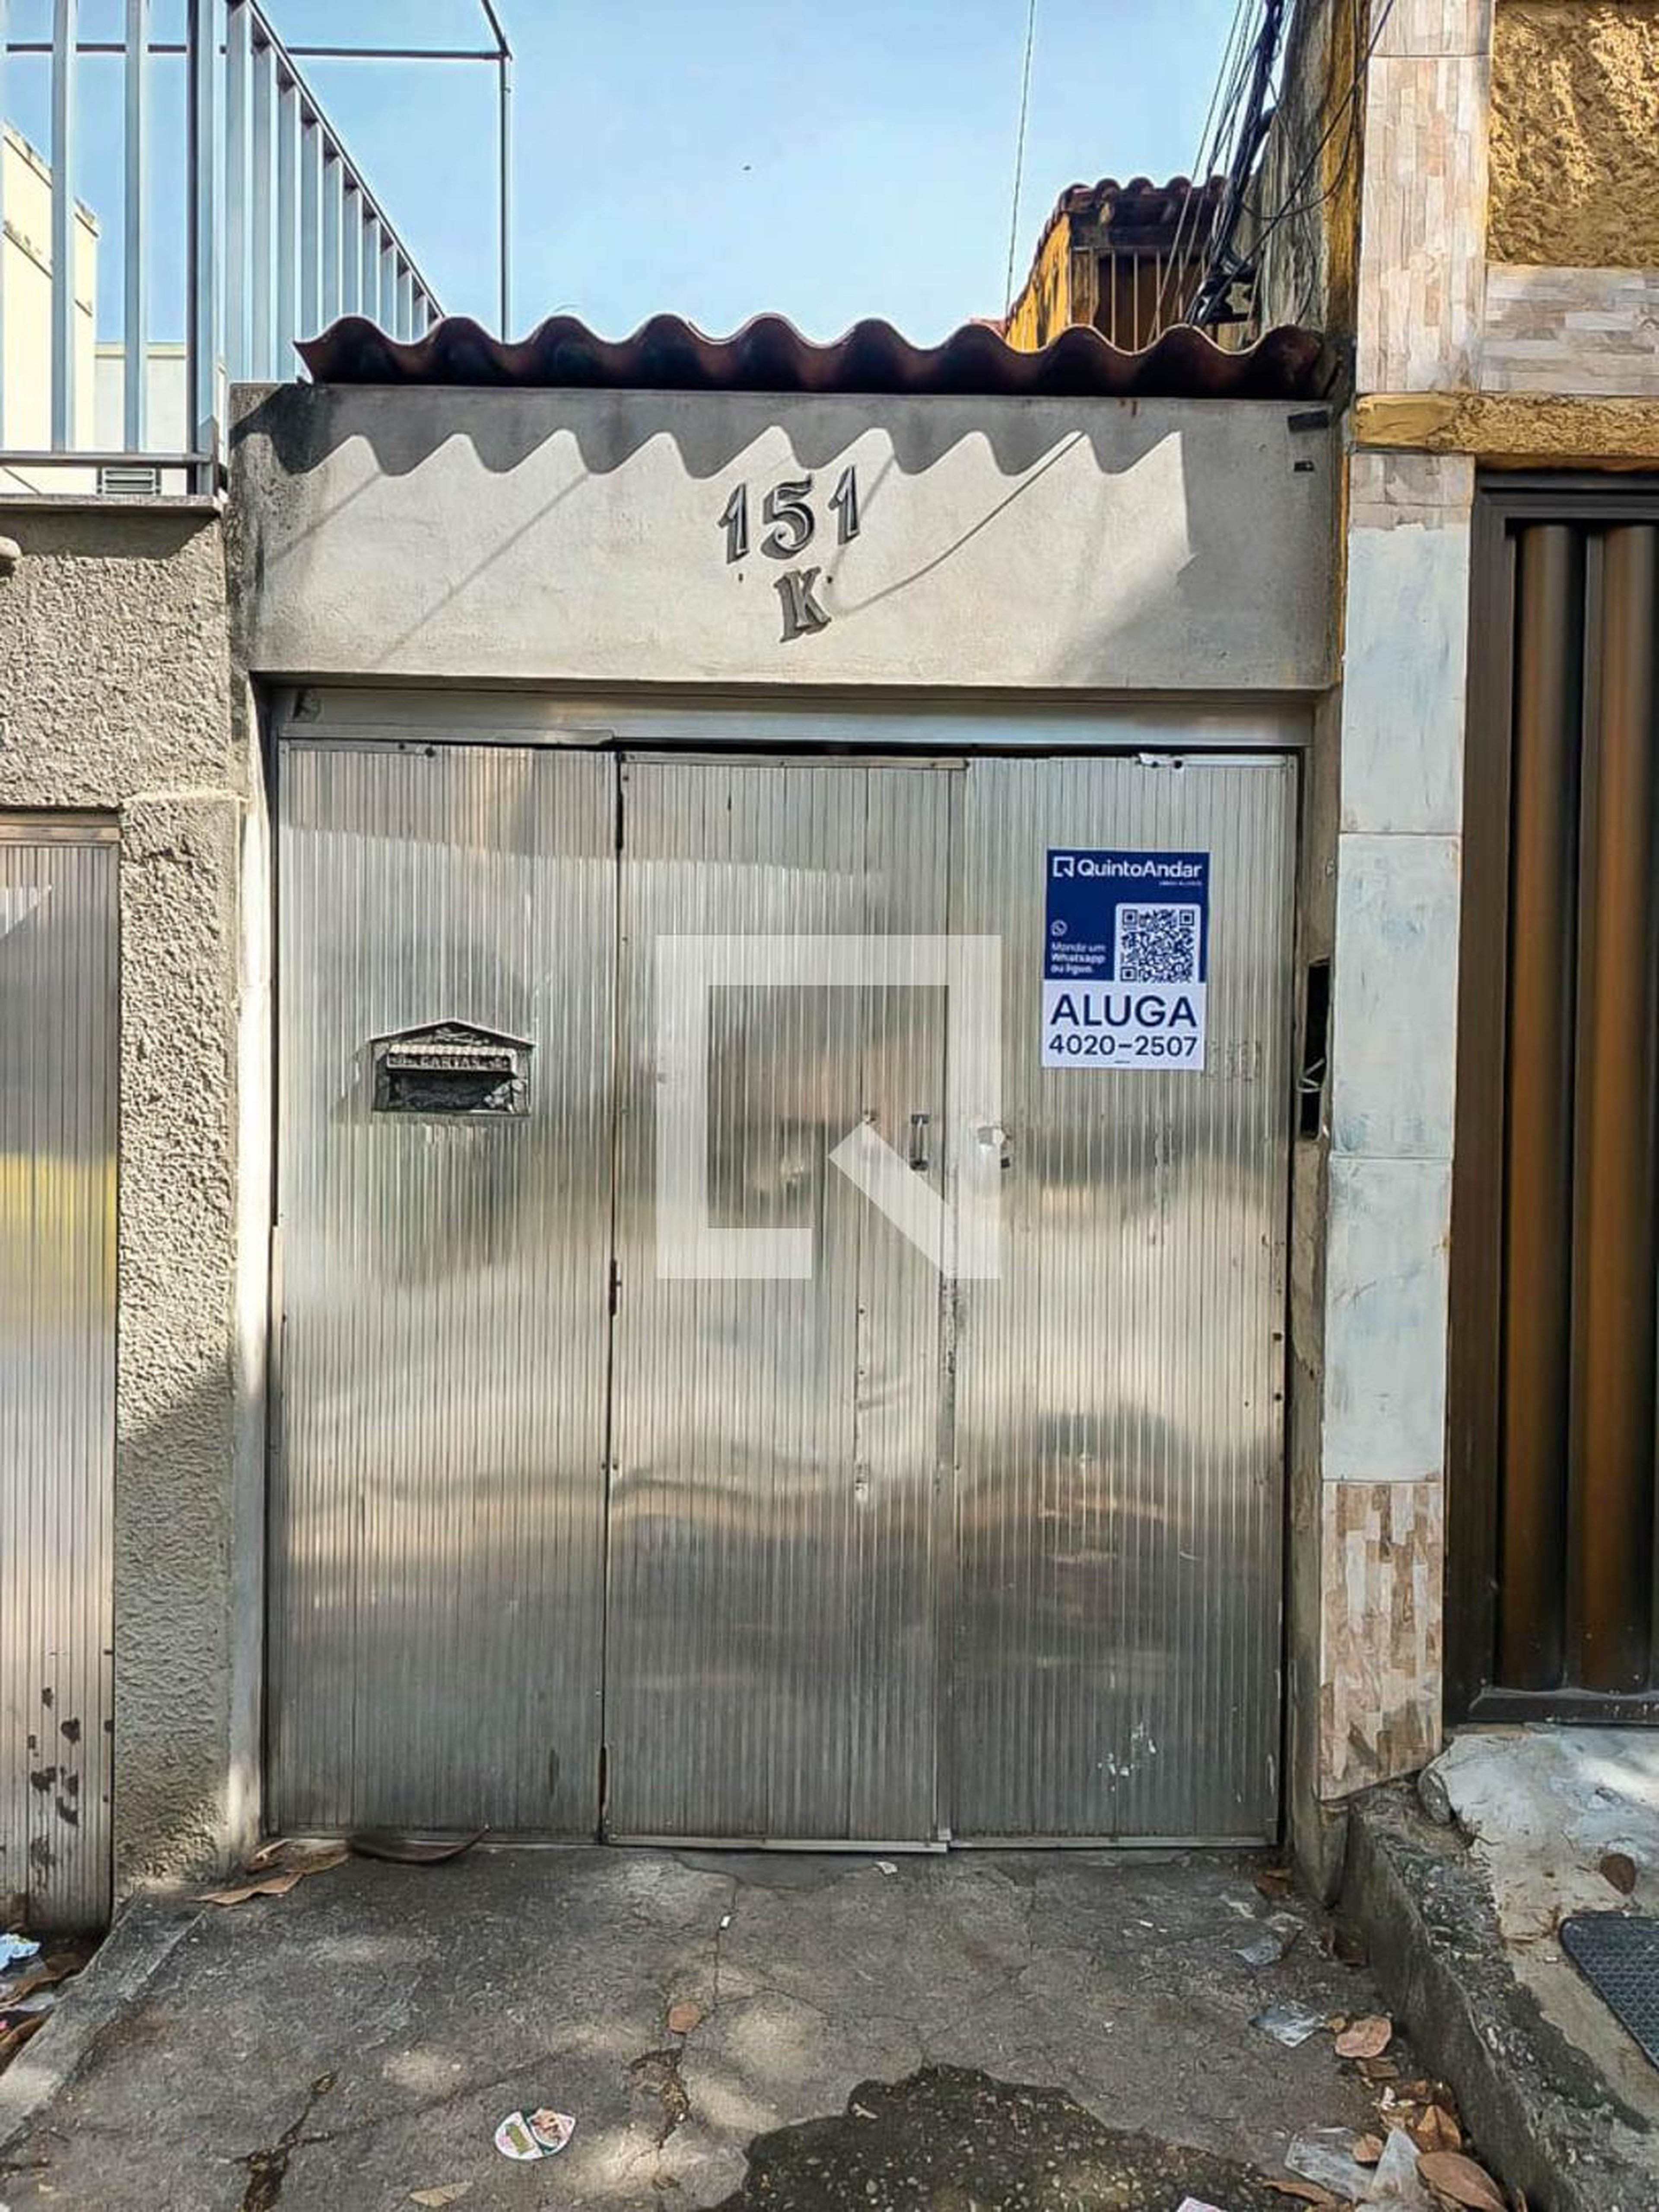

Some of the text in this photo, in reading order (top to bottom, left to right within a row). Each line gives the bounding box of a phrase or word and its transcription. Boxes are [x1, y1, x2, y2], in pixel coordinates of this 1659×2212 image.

[718, 465, 861, 564] 151
[773, 566, 832, 643] K
[1077, 859, 1202, 878] QuintoAndar
[1050, 994, 1197, 1027] ALUGA
[1049, 1034, 1197, 1057] 4020-2507
